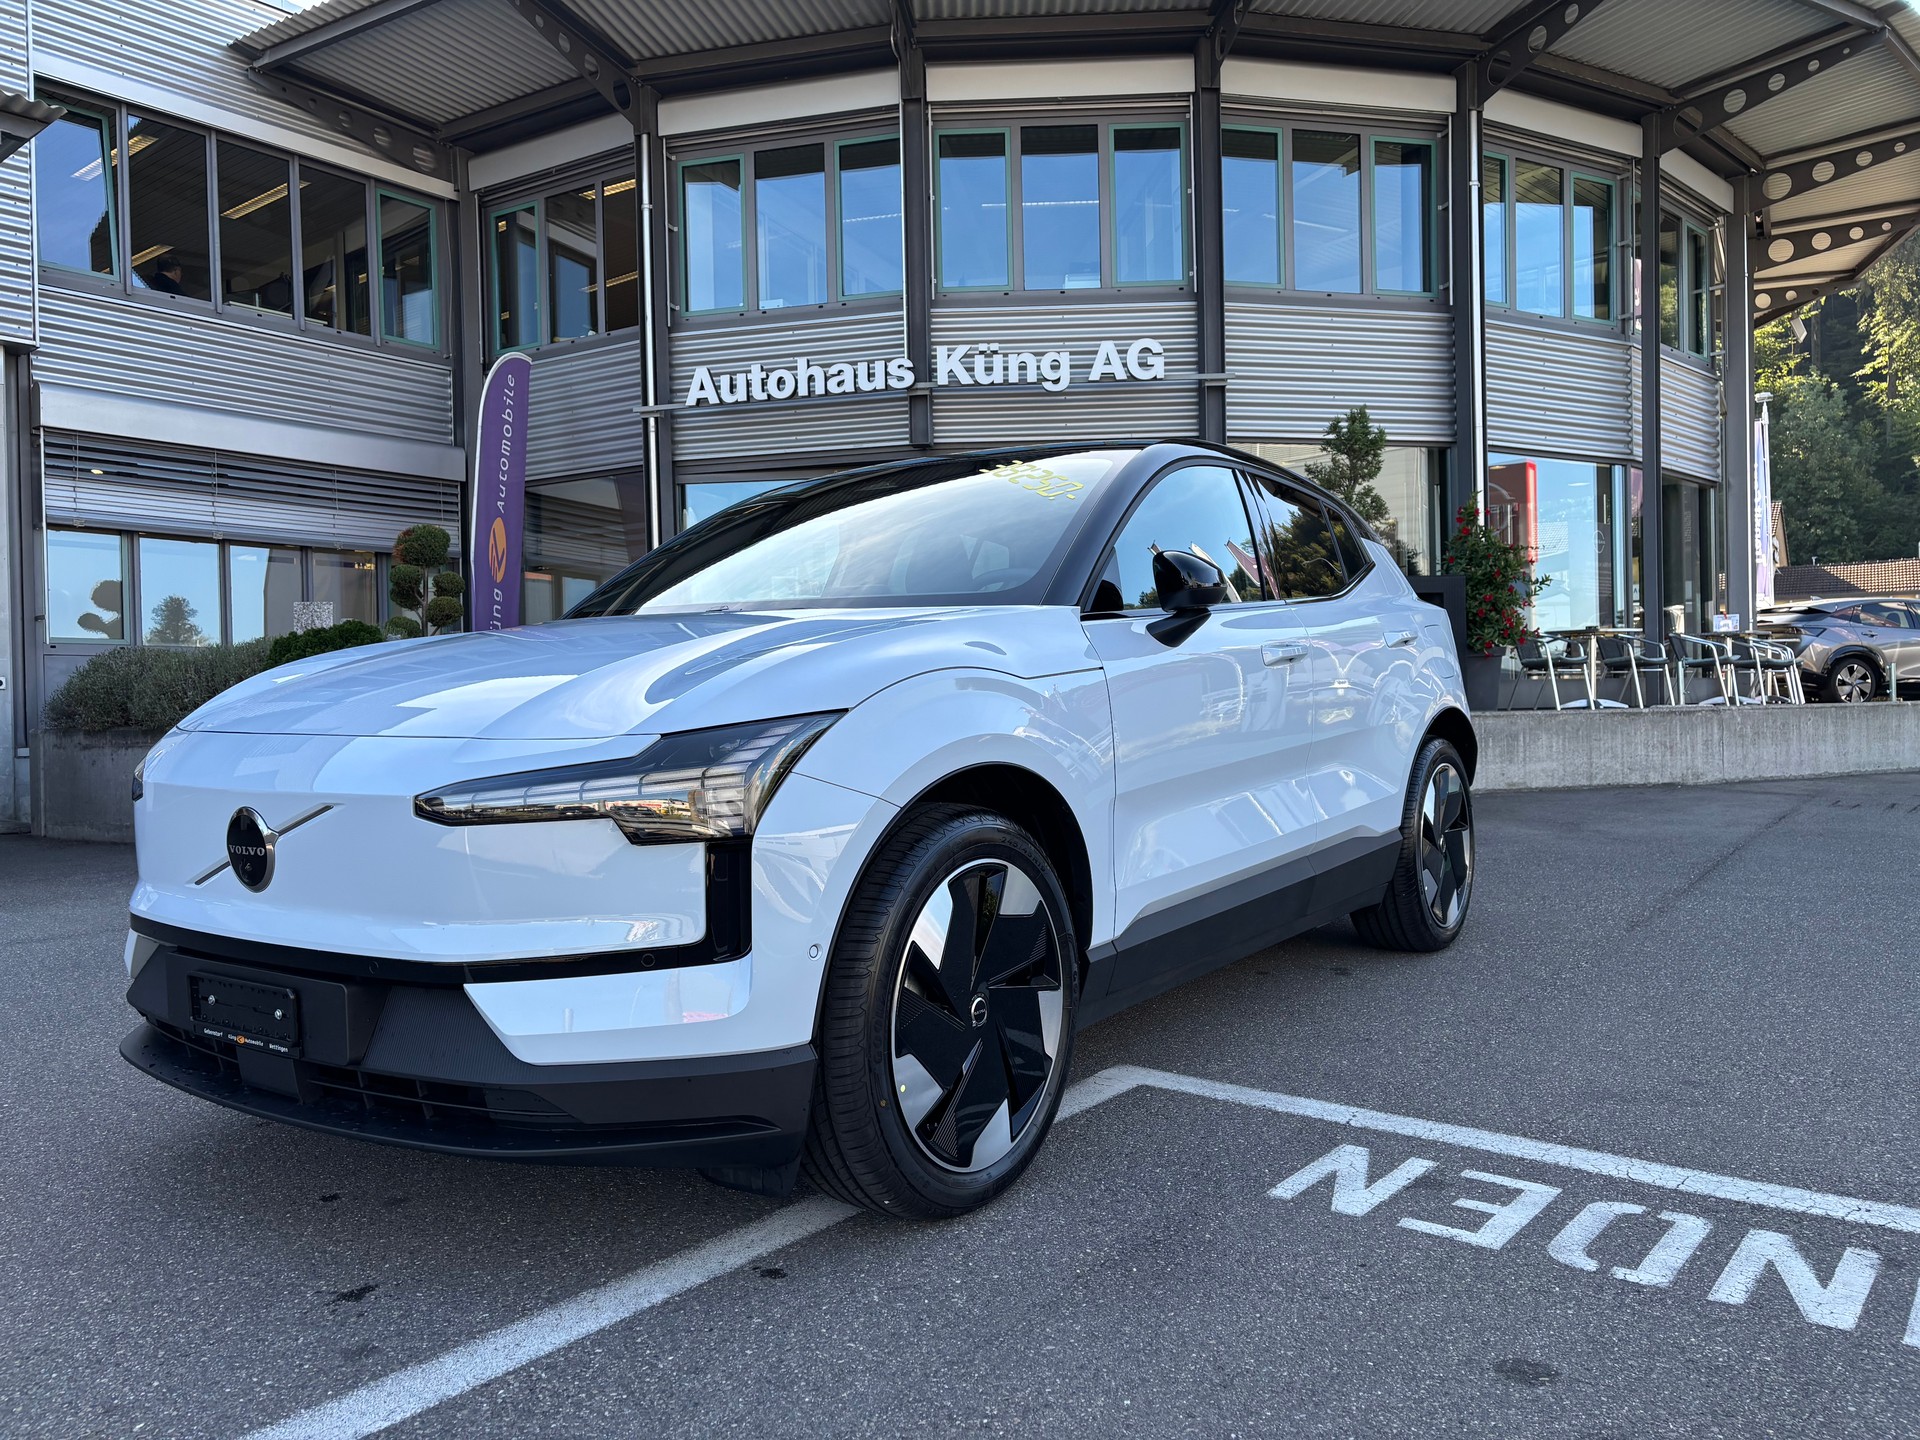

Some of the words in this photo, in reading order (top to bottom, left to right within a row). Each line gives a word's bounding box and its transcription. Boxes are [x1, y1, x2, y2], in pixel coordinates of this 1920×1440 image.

[685, 357, 915, 406] Autohaus
[937, 342, 1070, 392] Küng
[1088, 337, 1165, 382] AG
[489, 588, 503, 631] üng
[497, 373, 516, 514] Automobile
[228, 844, 266, 857] VOLVO
[1266, 1144, 1920, 1348] NDEN
